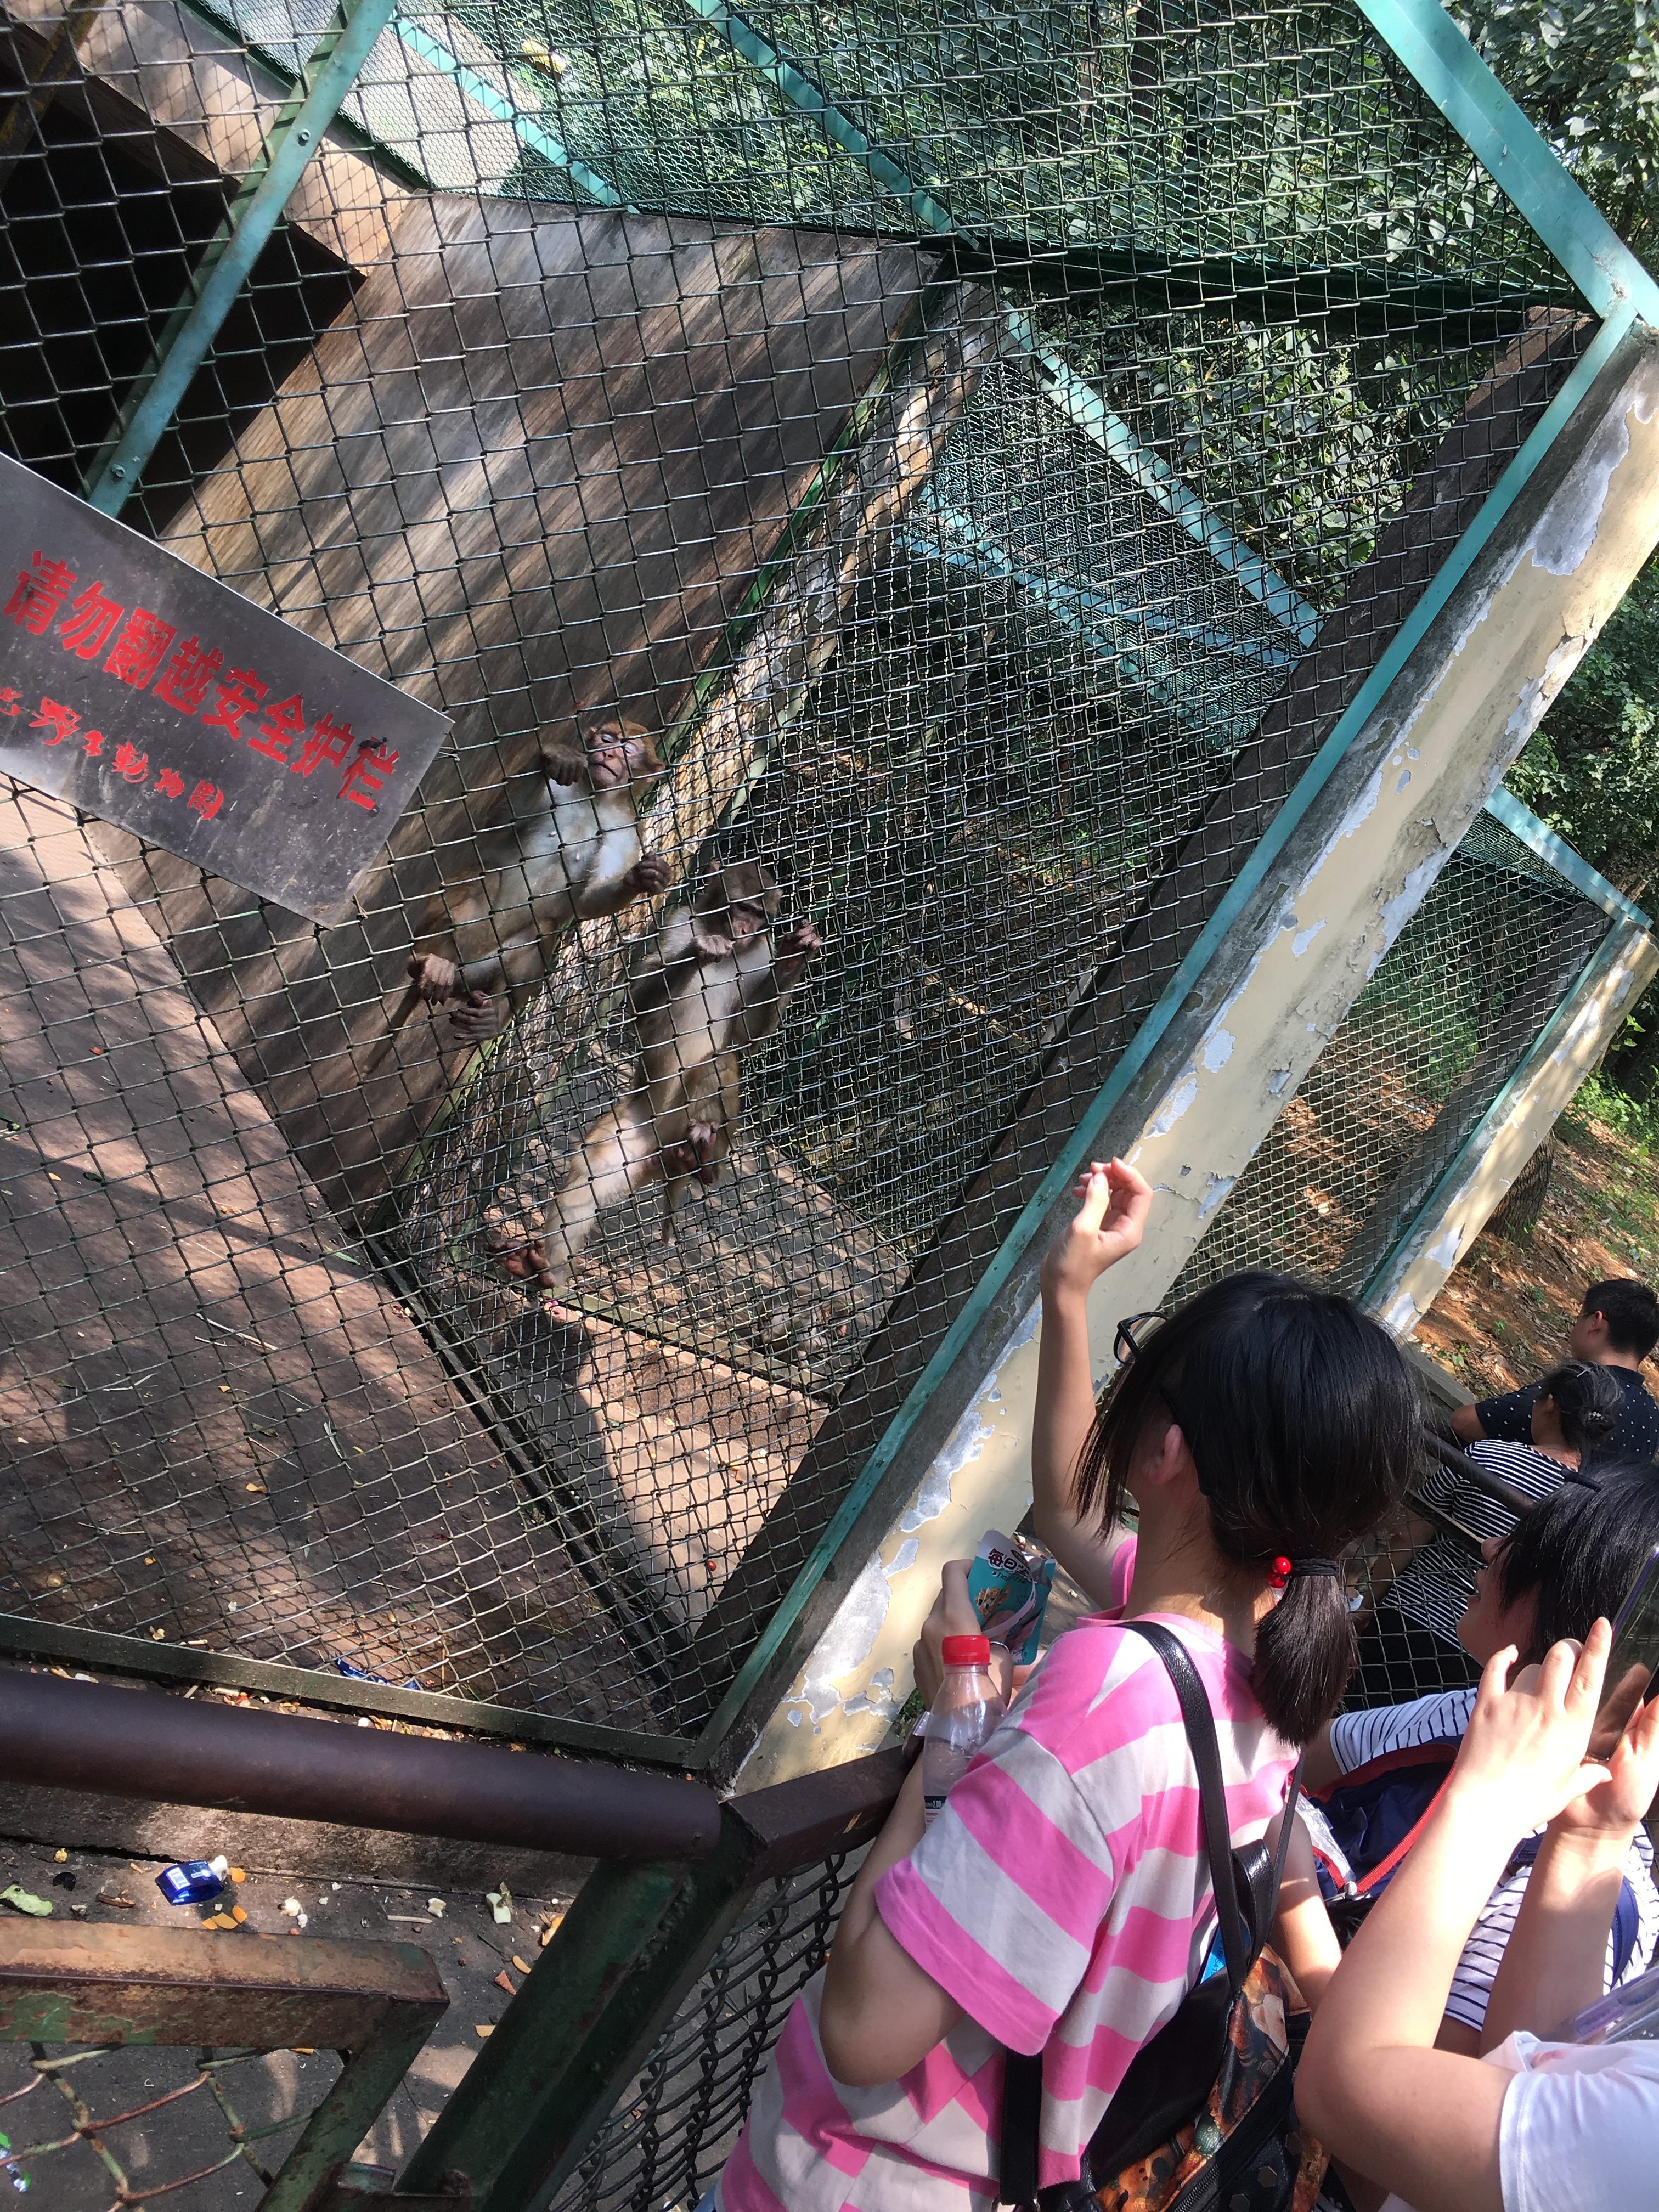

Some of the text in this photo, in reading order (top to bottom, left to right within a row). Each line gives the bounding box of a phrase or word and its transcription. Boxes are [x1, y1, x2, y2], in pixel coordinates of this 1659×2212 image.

[3, 550, 402, 811] 请勿翻越安全护栏
